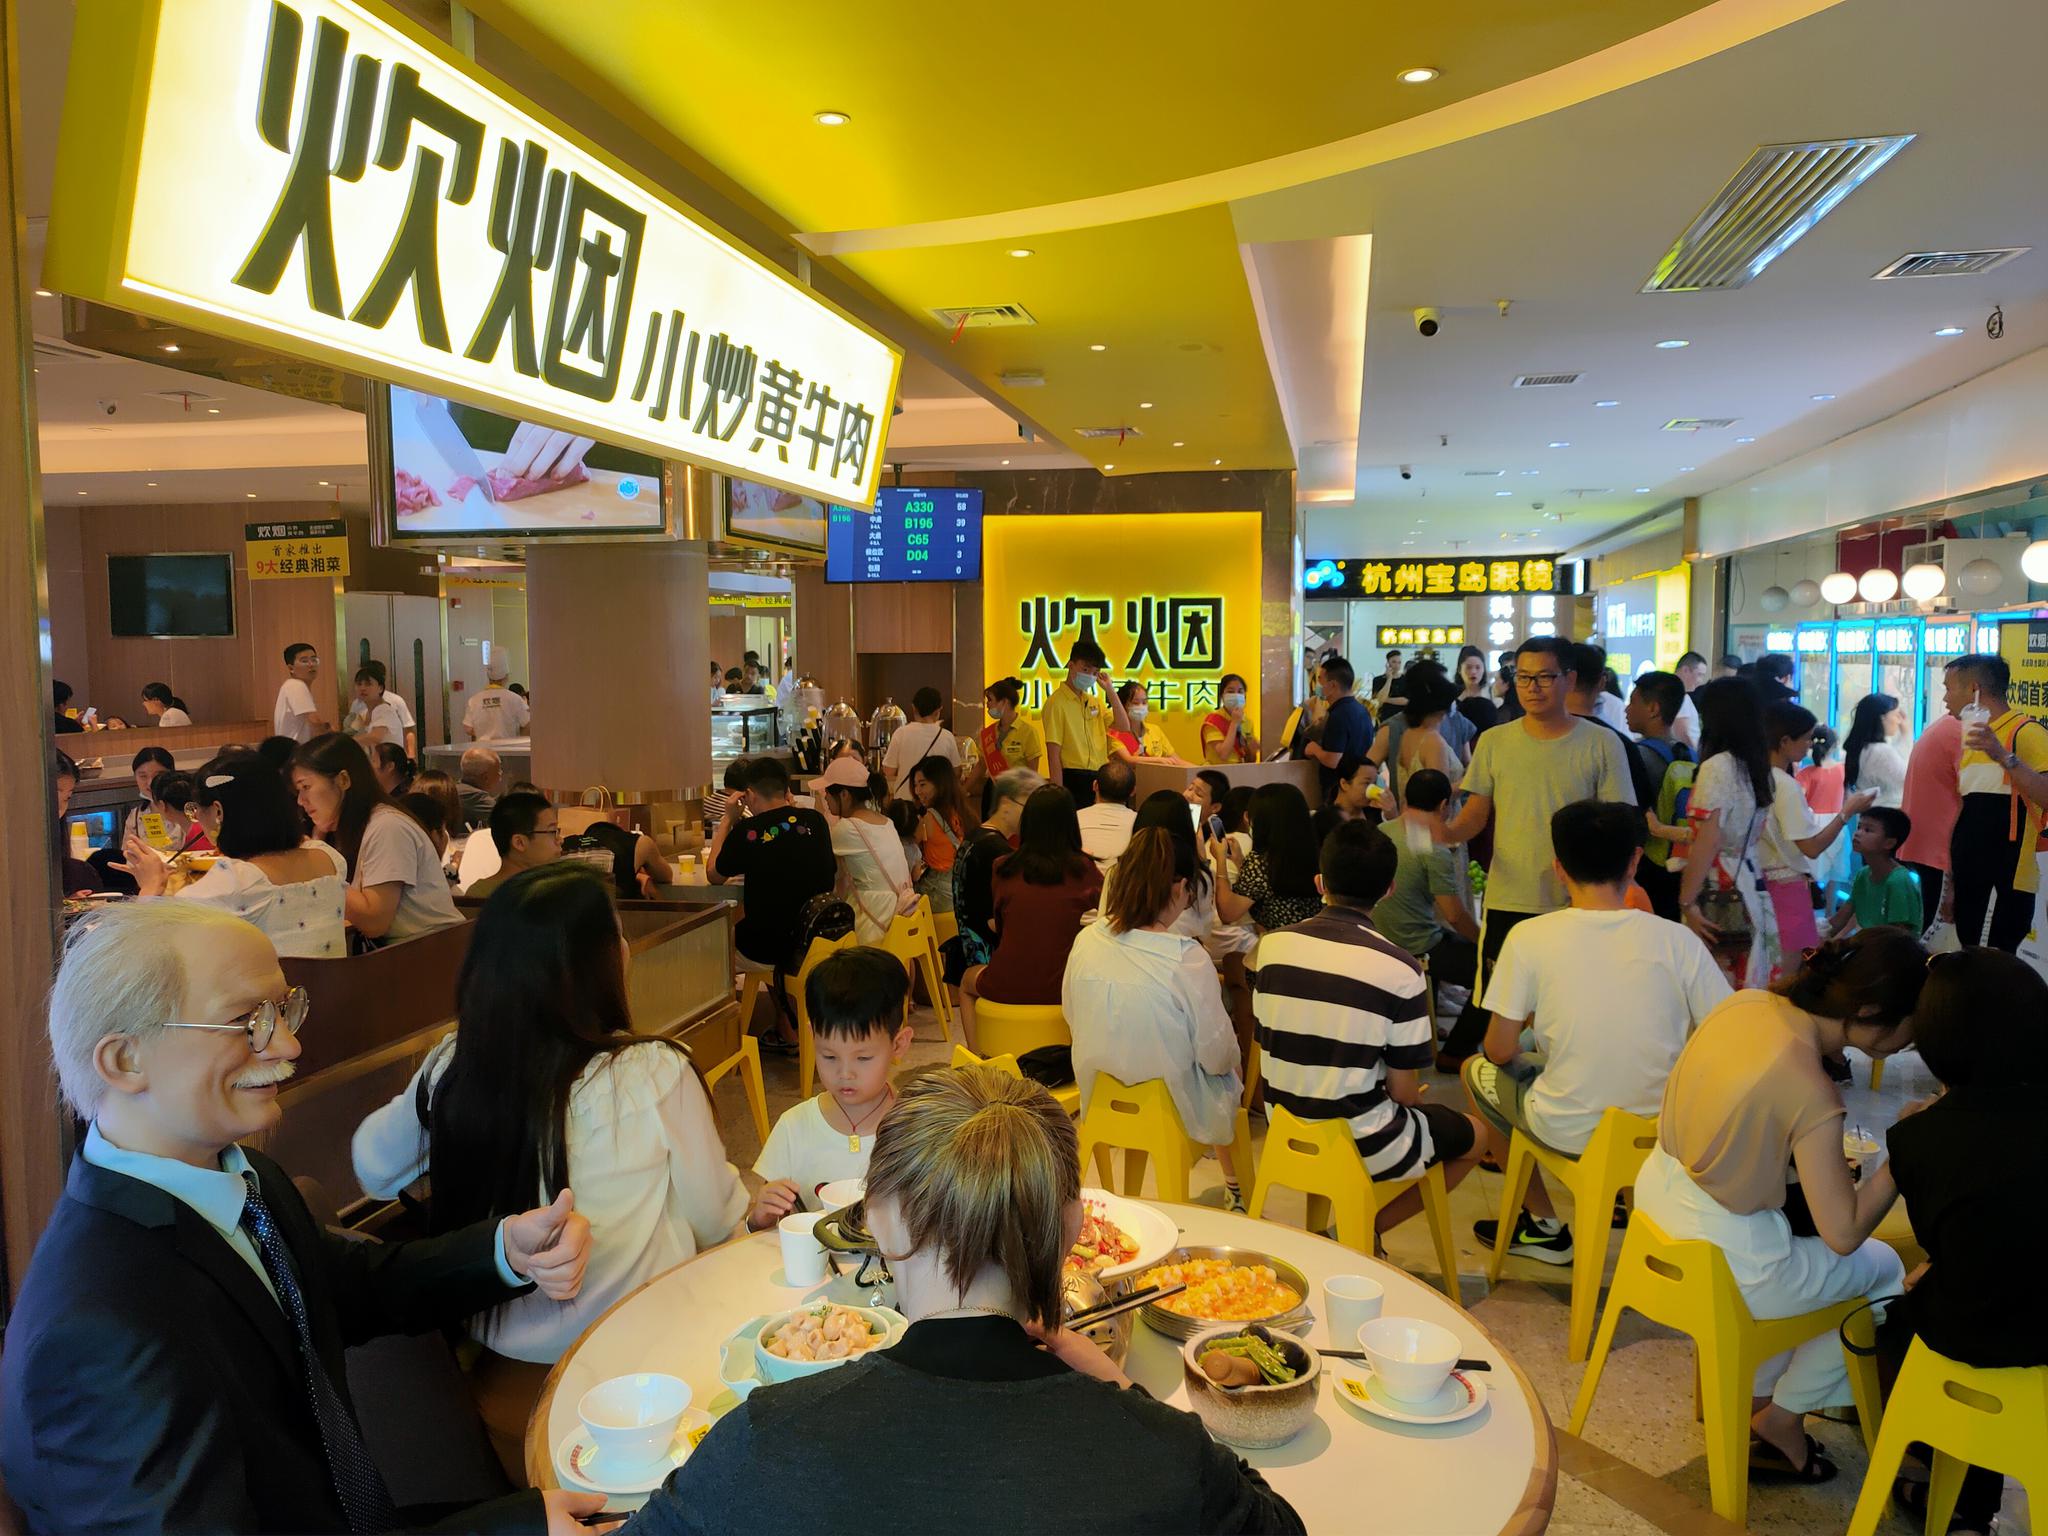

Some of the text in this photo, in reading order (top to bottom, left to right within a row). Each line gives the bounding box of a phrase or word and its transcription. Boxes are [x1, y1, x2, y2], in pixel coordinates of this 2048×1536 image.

[232, 1, 875, 487] 炊烟 小炒黄牛肉
[905, 501, 934, 513] A330
[904, 517, 934, 529] B196
[257, 524, 287, 538] 炊烟
[907, 533, 929, 545] C65
[956, 534, 965, 543] 16
[906, 549, 929, 561] D04
[956, 550, 963, 559] 3
[256, 556, 341, 575] 9大经典湘菜
[955, 566, 962, 575] 0
[1361, 559, 1554, 594] 杭州宝岛眼镜
[1020, 596, 1223, 669] 炊烟
[1020, 679, 1222, 711] 小牛肉
